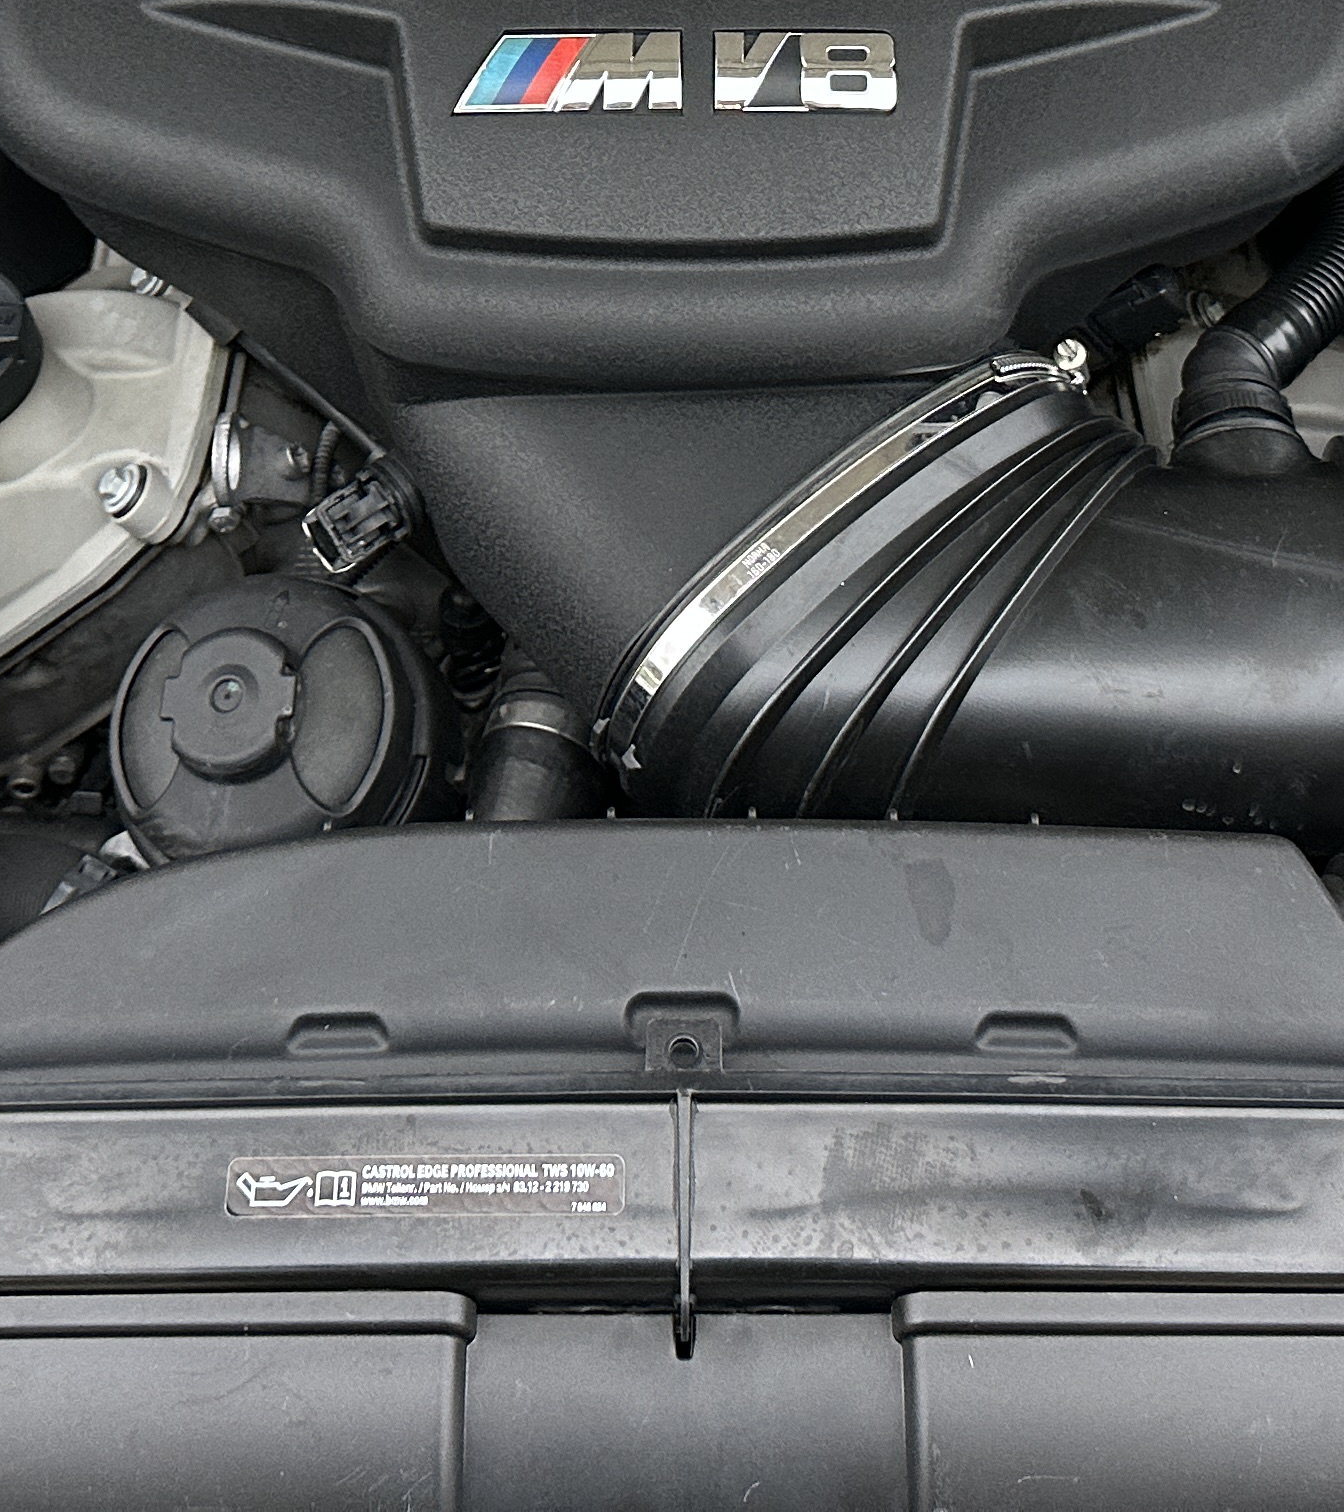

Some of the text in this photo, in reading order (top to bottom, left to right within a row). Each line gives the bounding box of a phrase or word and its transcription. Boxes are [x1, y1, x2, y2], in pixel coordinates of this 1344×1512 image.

[362, 1163, 615, 1179] CASTROL EDGE PROFESSIONAL TWS 10W-60
